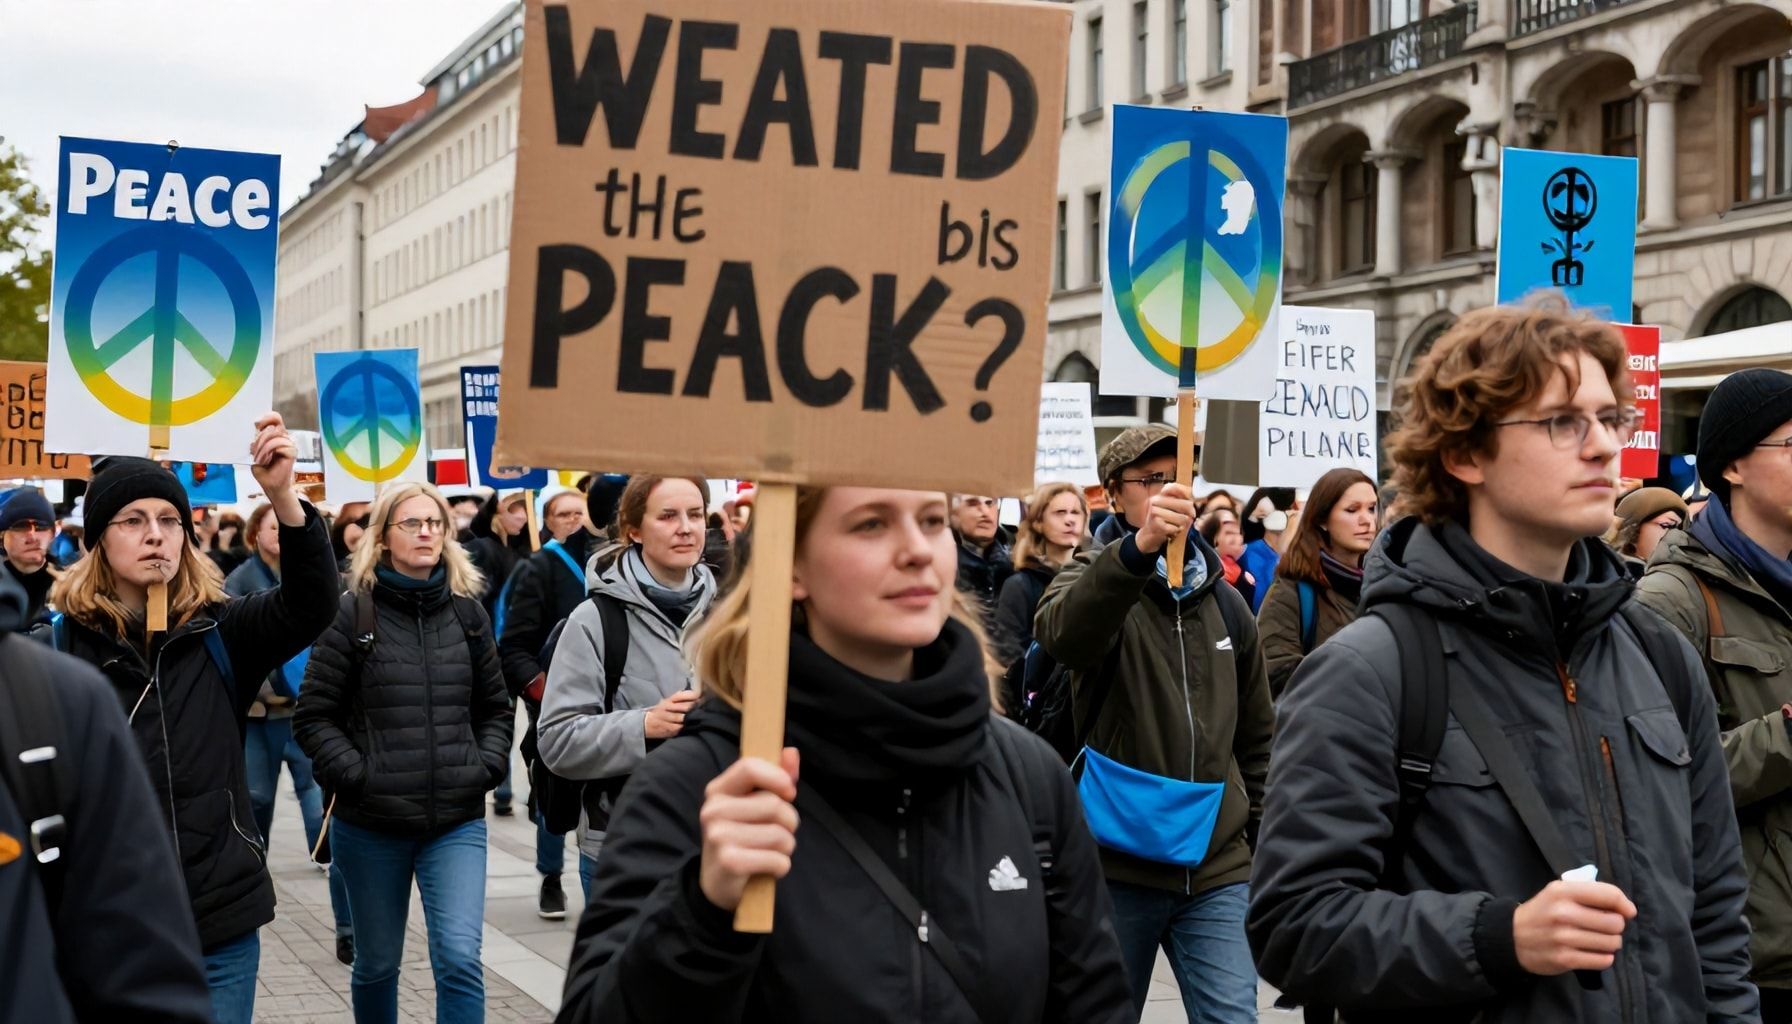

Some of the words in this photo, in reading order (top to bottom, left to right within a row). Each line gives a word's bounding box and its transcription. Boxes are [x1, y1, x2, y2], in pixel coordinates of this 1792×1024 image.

[543, 4, 1038, 181] WEATED
[937, 200, 1019, 271] bis
[528, 243, 1026, 423] PEACK?
